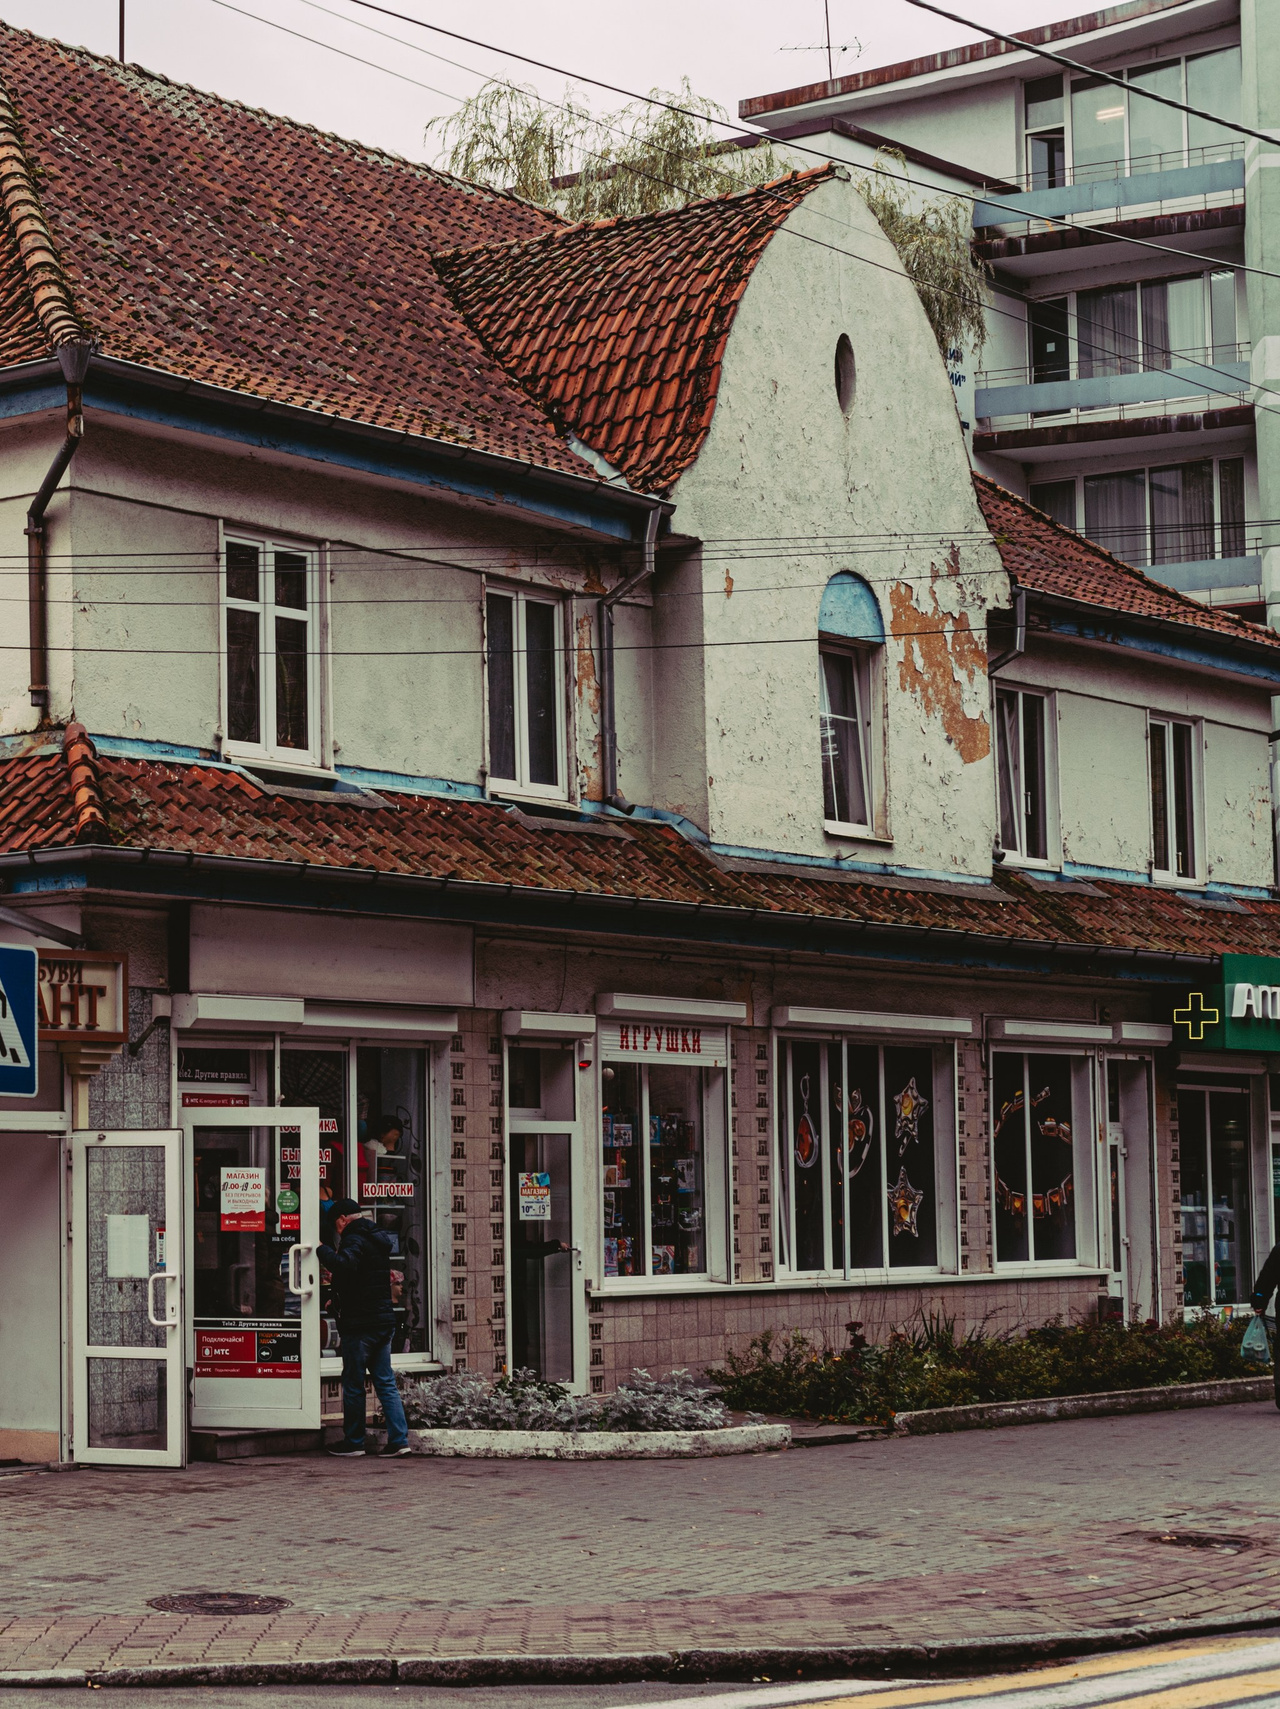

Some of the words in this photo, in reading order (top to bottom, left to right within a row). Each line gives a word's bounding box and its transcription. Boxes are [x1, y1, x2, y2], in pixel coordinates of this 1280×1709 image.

[619, 1024, 702, 1053] ИГРУШКИ
[194, 1069, 219, 1081] Другие
[220, 1072, 248, 1081] правила
[363, 1183, 414, 1198] КОЛГОТКИ
